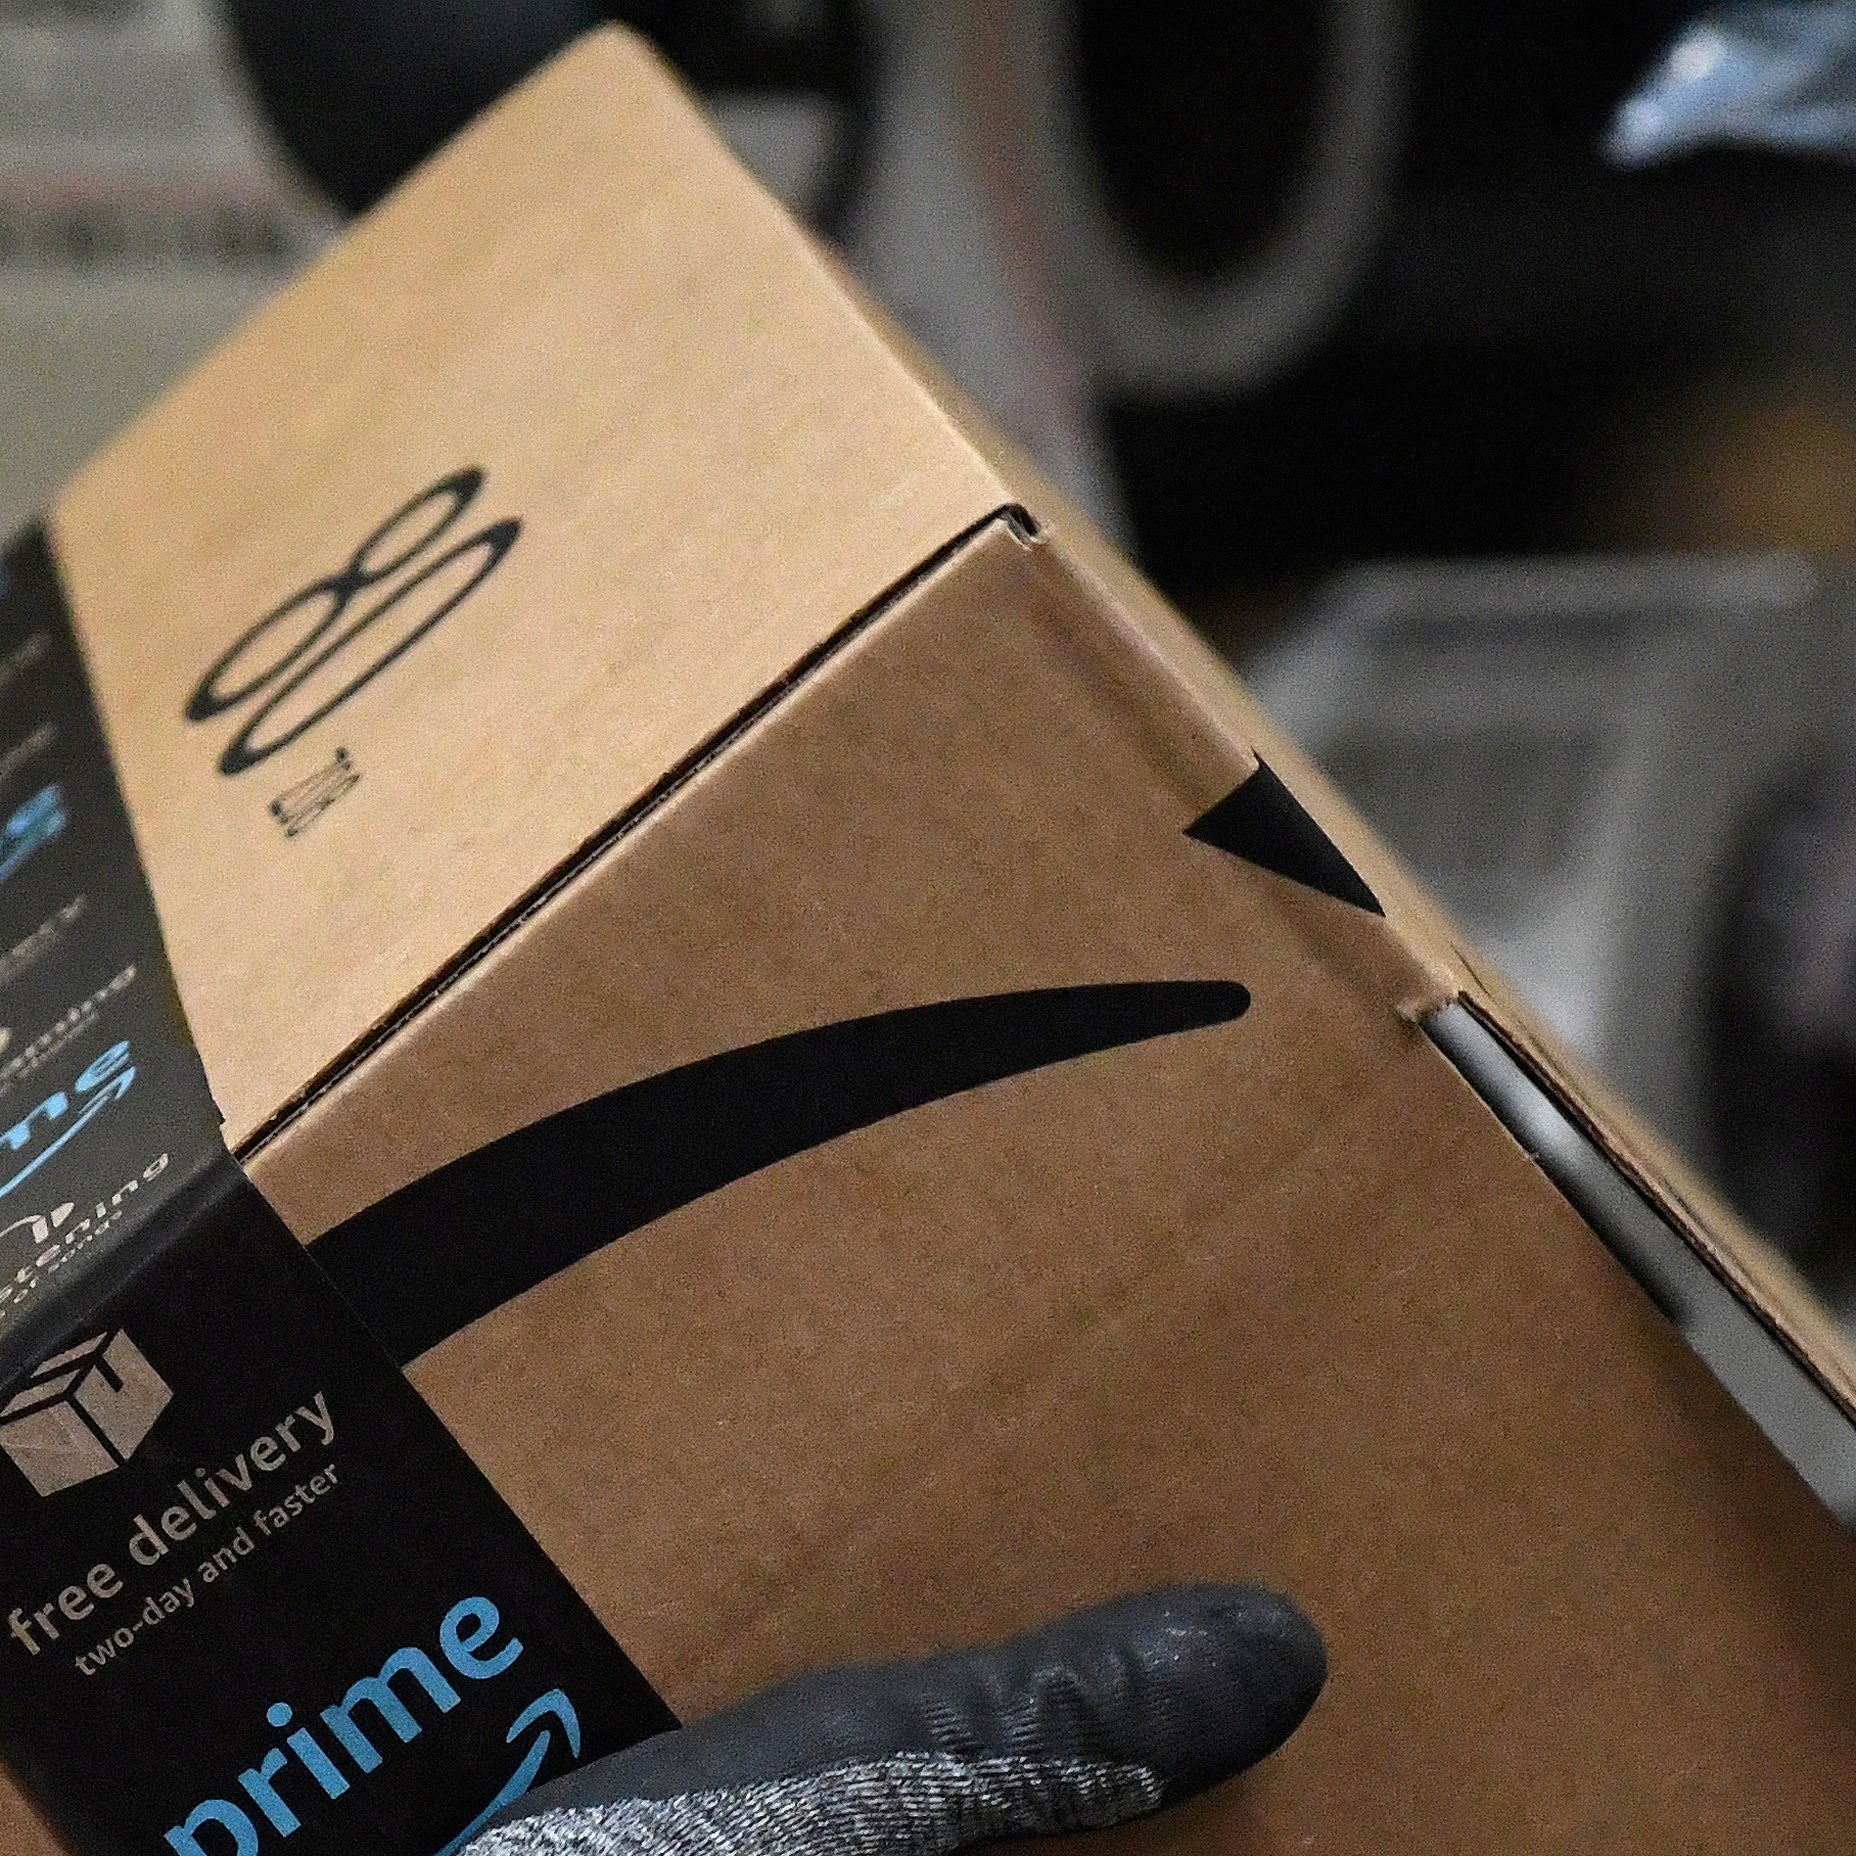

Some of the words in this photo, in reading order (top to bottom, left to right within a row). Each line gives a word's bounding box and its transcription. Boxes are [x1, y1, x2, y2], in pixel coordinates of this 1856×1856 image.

[7, 1556, 124, 1658] free
[129, 1390, 336, 1570] delivery
[75, 1578, 195, 1678] two-day
[198, 1528, 256, 1585] and
[254, 1461, 342, 1540] faster
